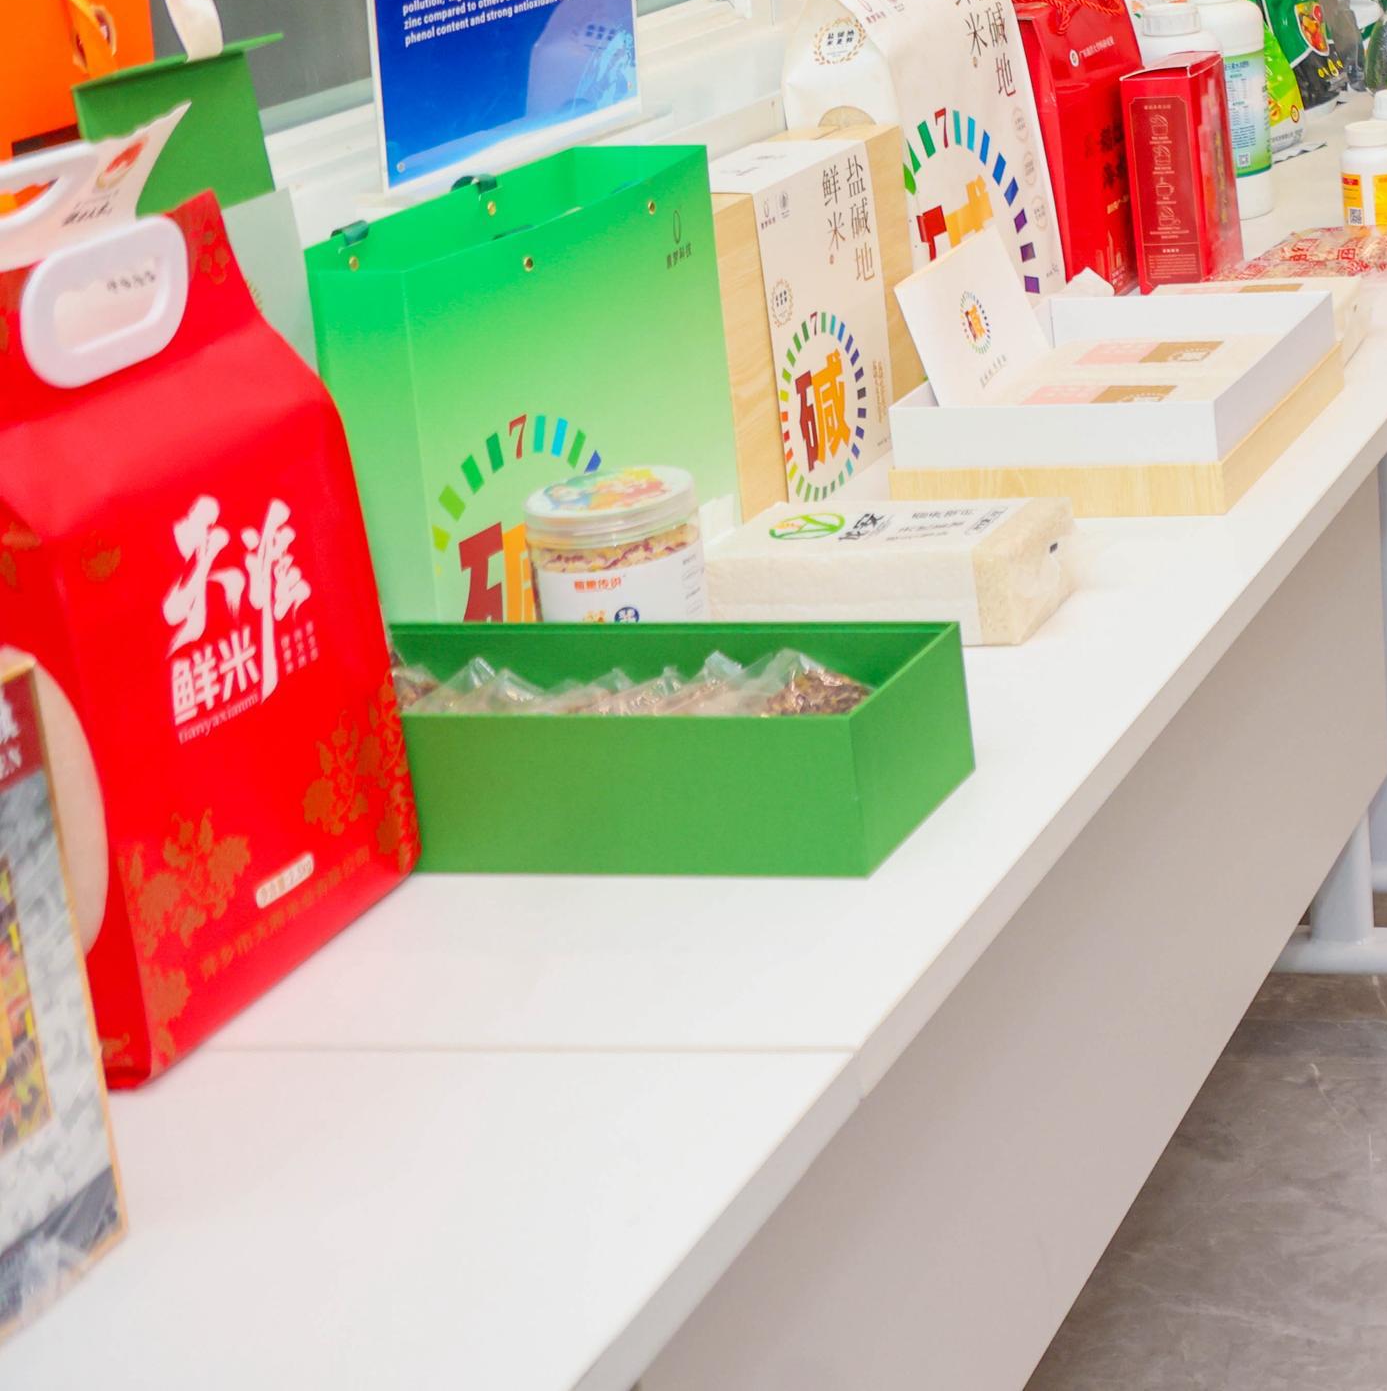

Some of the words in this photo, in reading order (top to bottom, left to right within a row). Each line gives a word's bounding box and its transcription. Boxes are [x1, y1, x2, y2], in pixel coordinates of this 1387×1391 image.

[404, 15, 422, 30] zinc
[423, 1, 465, 25] compared
[467, 0, 477, 11] to
[404, 30, 435, 48] phenol
[436, 18, 469, 35] content
[470, 12, 486, 27] and
[486, 4, 513, 22] strong
[822, 164, 846, 251] 鲜米
[846, 154, 875, 281] 盐碱地
[810, 311, 818, 336] 7
[509, 414, 527, 459] 7
[795, 348, 851, 473] 碱
[172, 626, 260, 726] 鲜米
